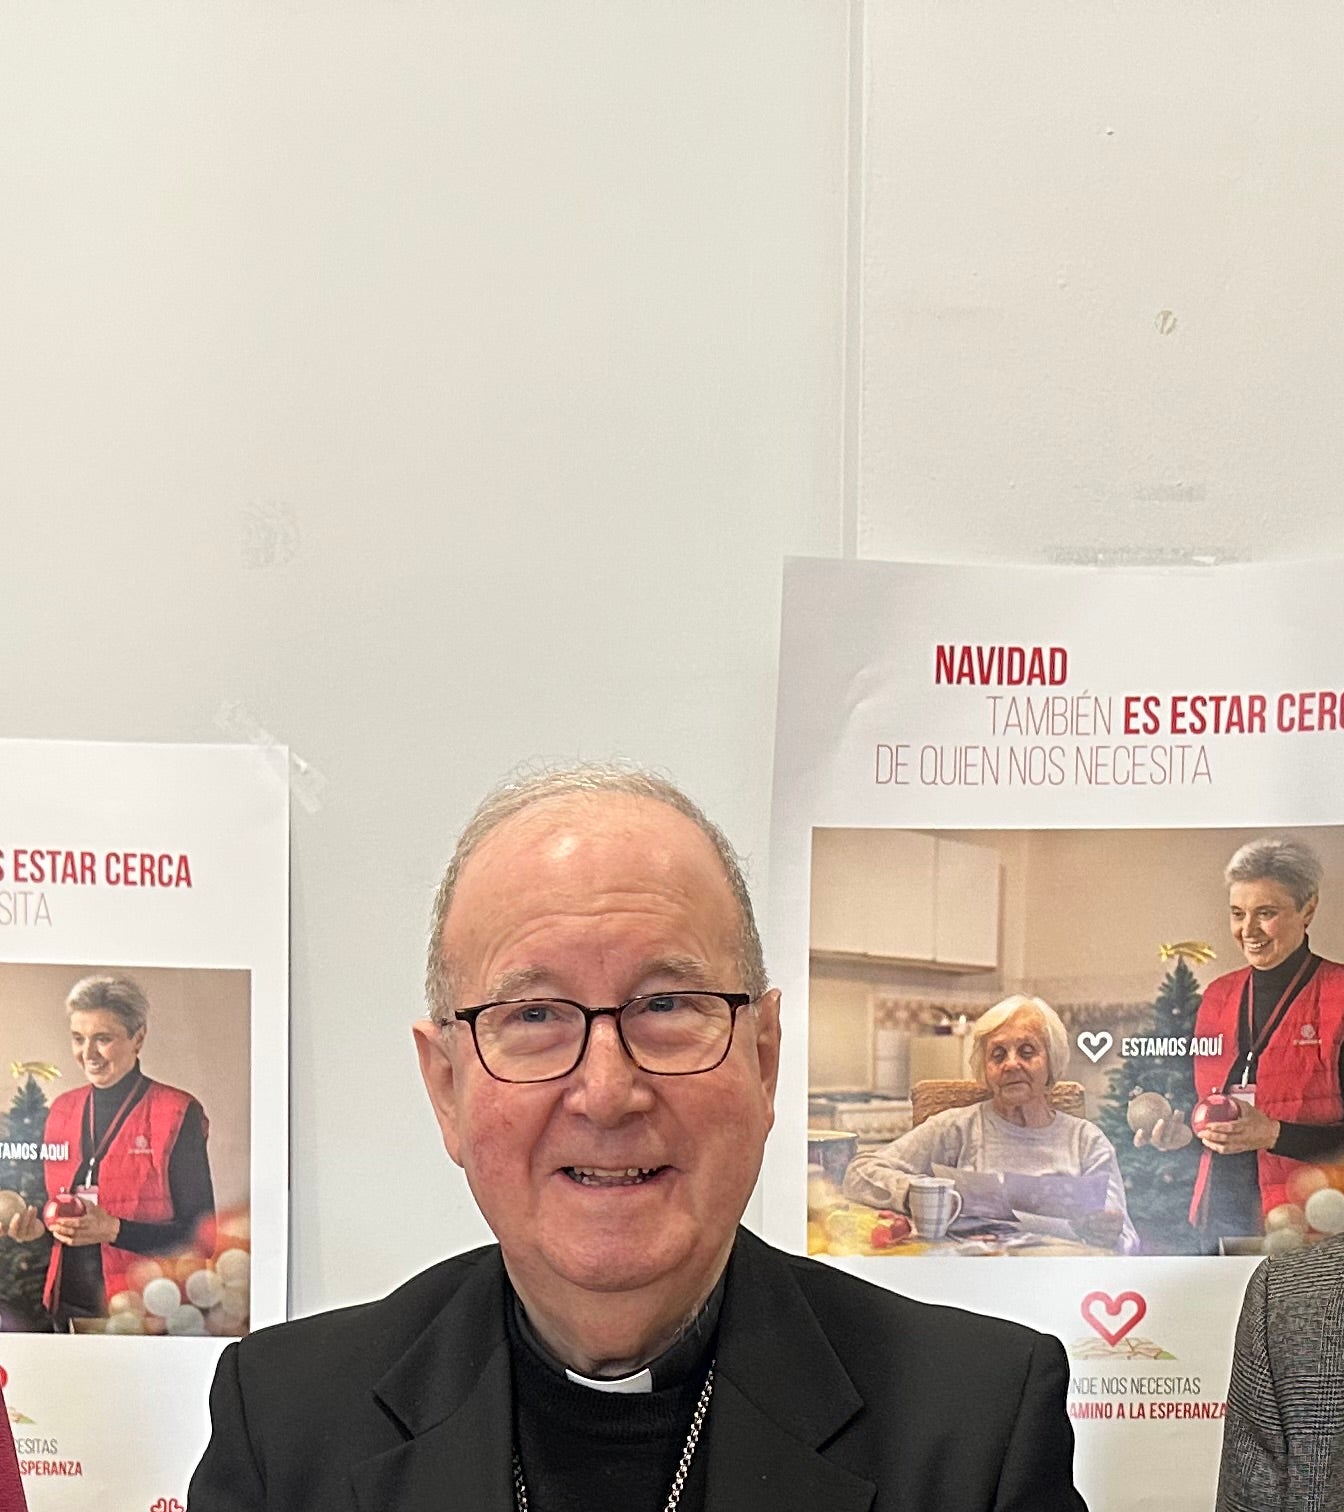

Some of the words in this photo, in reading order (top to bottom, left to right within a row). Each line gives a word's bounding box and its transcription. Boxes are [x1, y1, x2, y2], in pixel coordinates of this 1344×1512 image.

[934, 644, 1068, 687] NAVIDAD
[986, 690, 1113, 737] TAMBIÉN
[1122, 696, 1160, 736] ES
[1170, 693, 1267, 736] ESTAR
[874, 743, 910, 786] DE
[919, 744, 1000, 787] QUIEN
[1008, 744, 1066, 787] NOS
[1074, 743, 1213, 786] NECESITA
[13, 849, 97, 886] ESTAR
[104, 851, 193, 889] CERCA
[1121, 1037, 1187, 1057] ESTAMOS
[1189, 1033, 1223, 1057] AQUÍ
[39, 1141, 70, 1161] AQUÍ
[1070, 1376, 1098, 1395] NDE
[1101, 1376, 1128, 1395] NOS
[1130, 1376, 1201, 1395] NECESITAS
[1069, 1402, 1113, 1419] AMINO
[1116, 1402, 1126, 1419] A
[1129, 1402, 1146, 1419] LA
[1149, 1402, 1228, 1420] ESPERANZA
[15, 1438, 58, 1455] ESITAS
[20, 1460, 83, 1476] SPERANZA
